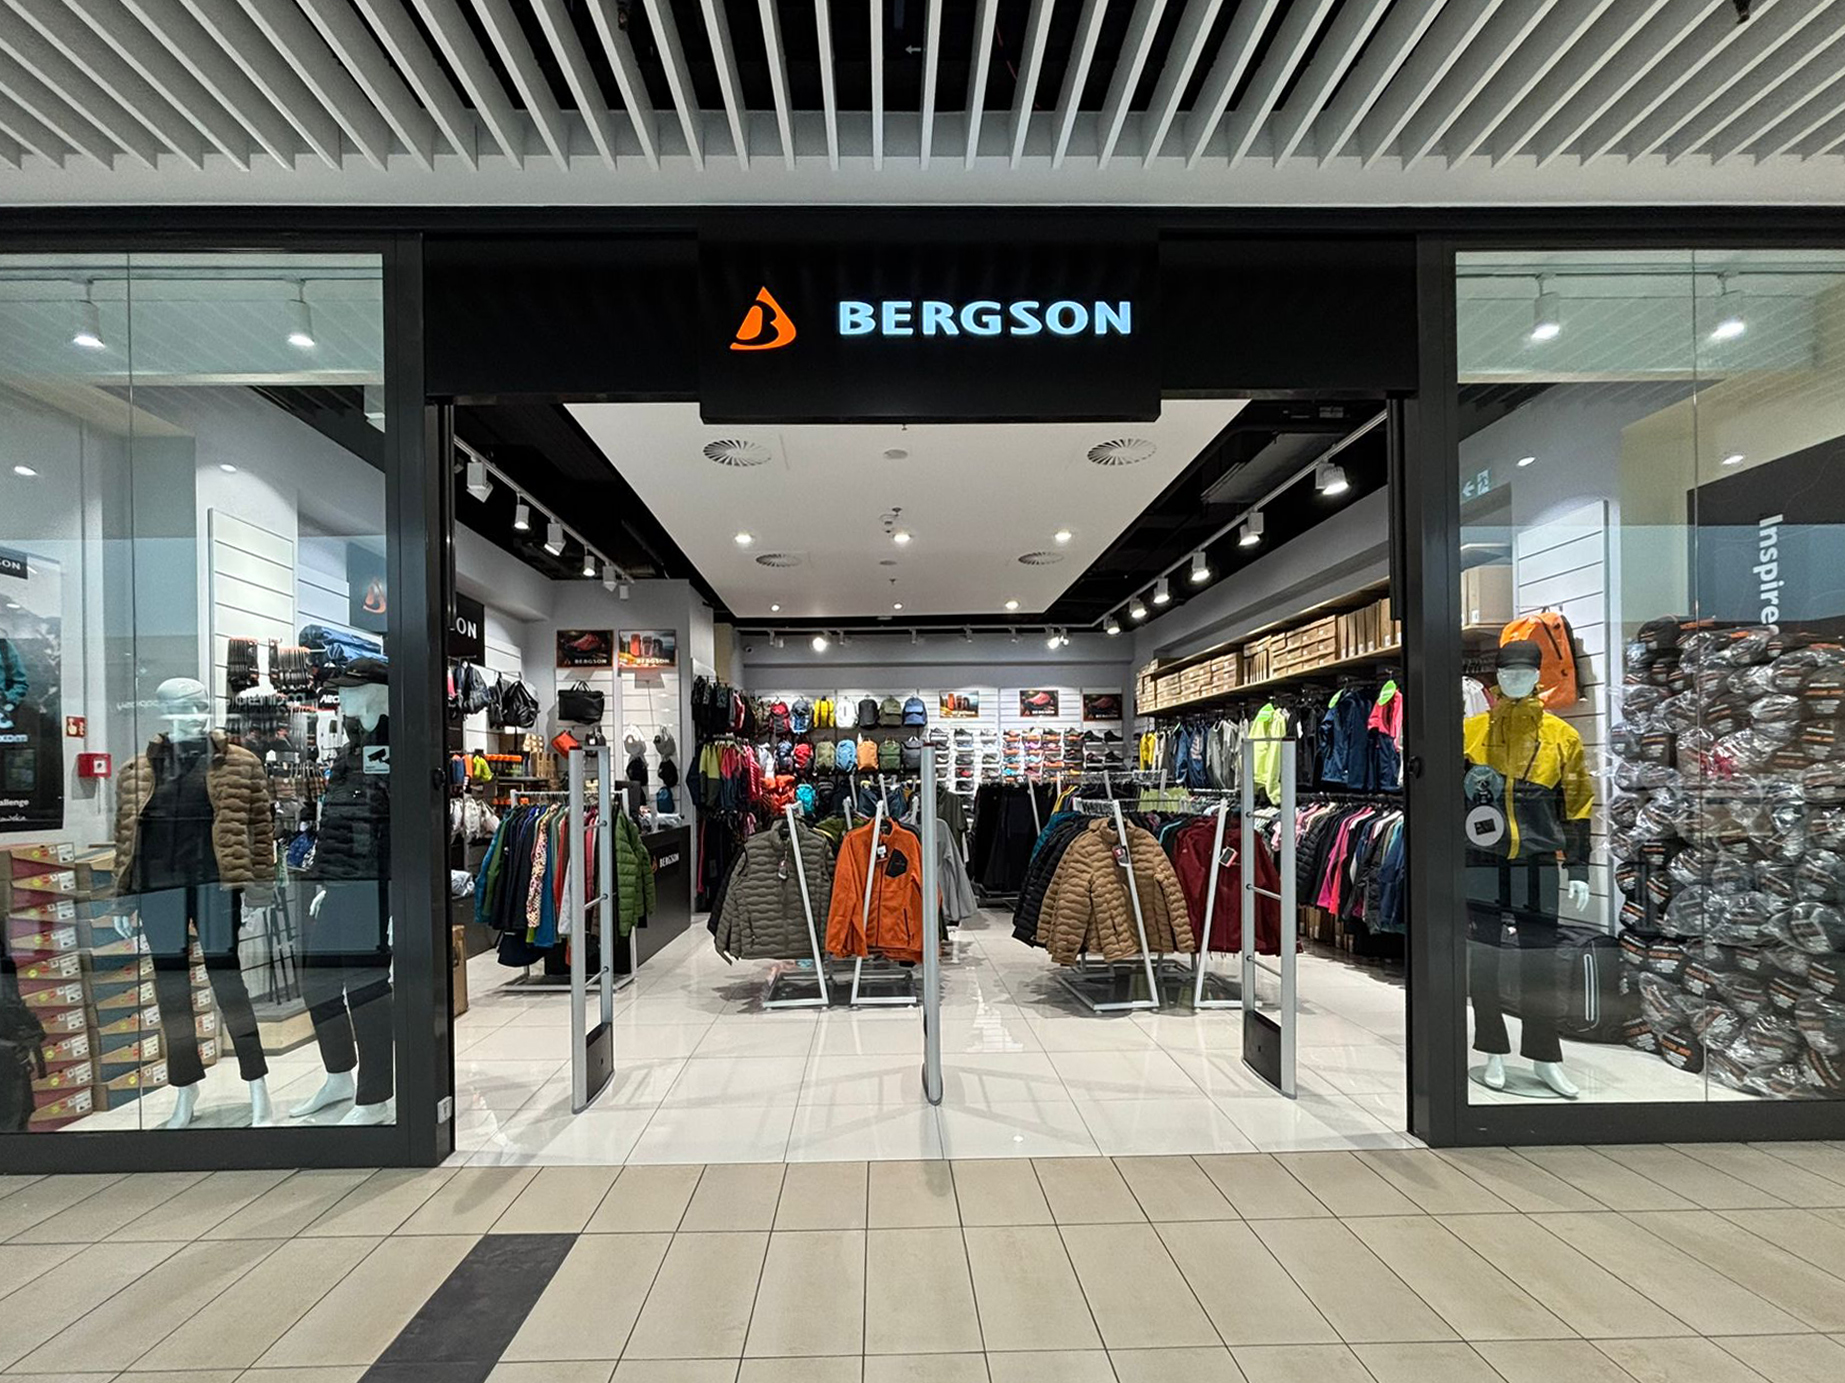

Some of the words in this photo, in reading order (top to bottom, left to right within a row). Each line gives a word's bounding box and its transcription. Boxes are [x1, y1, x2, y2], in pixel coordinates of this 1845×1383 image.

[838, 300, 1132, 335] BERGSON
[0, 559, 21, 570] ON
[1753, 514, 1784, 624] Inspire
[450, 617, 477, 639] ON
